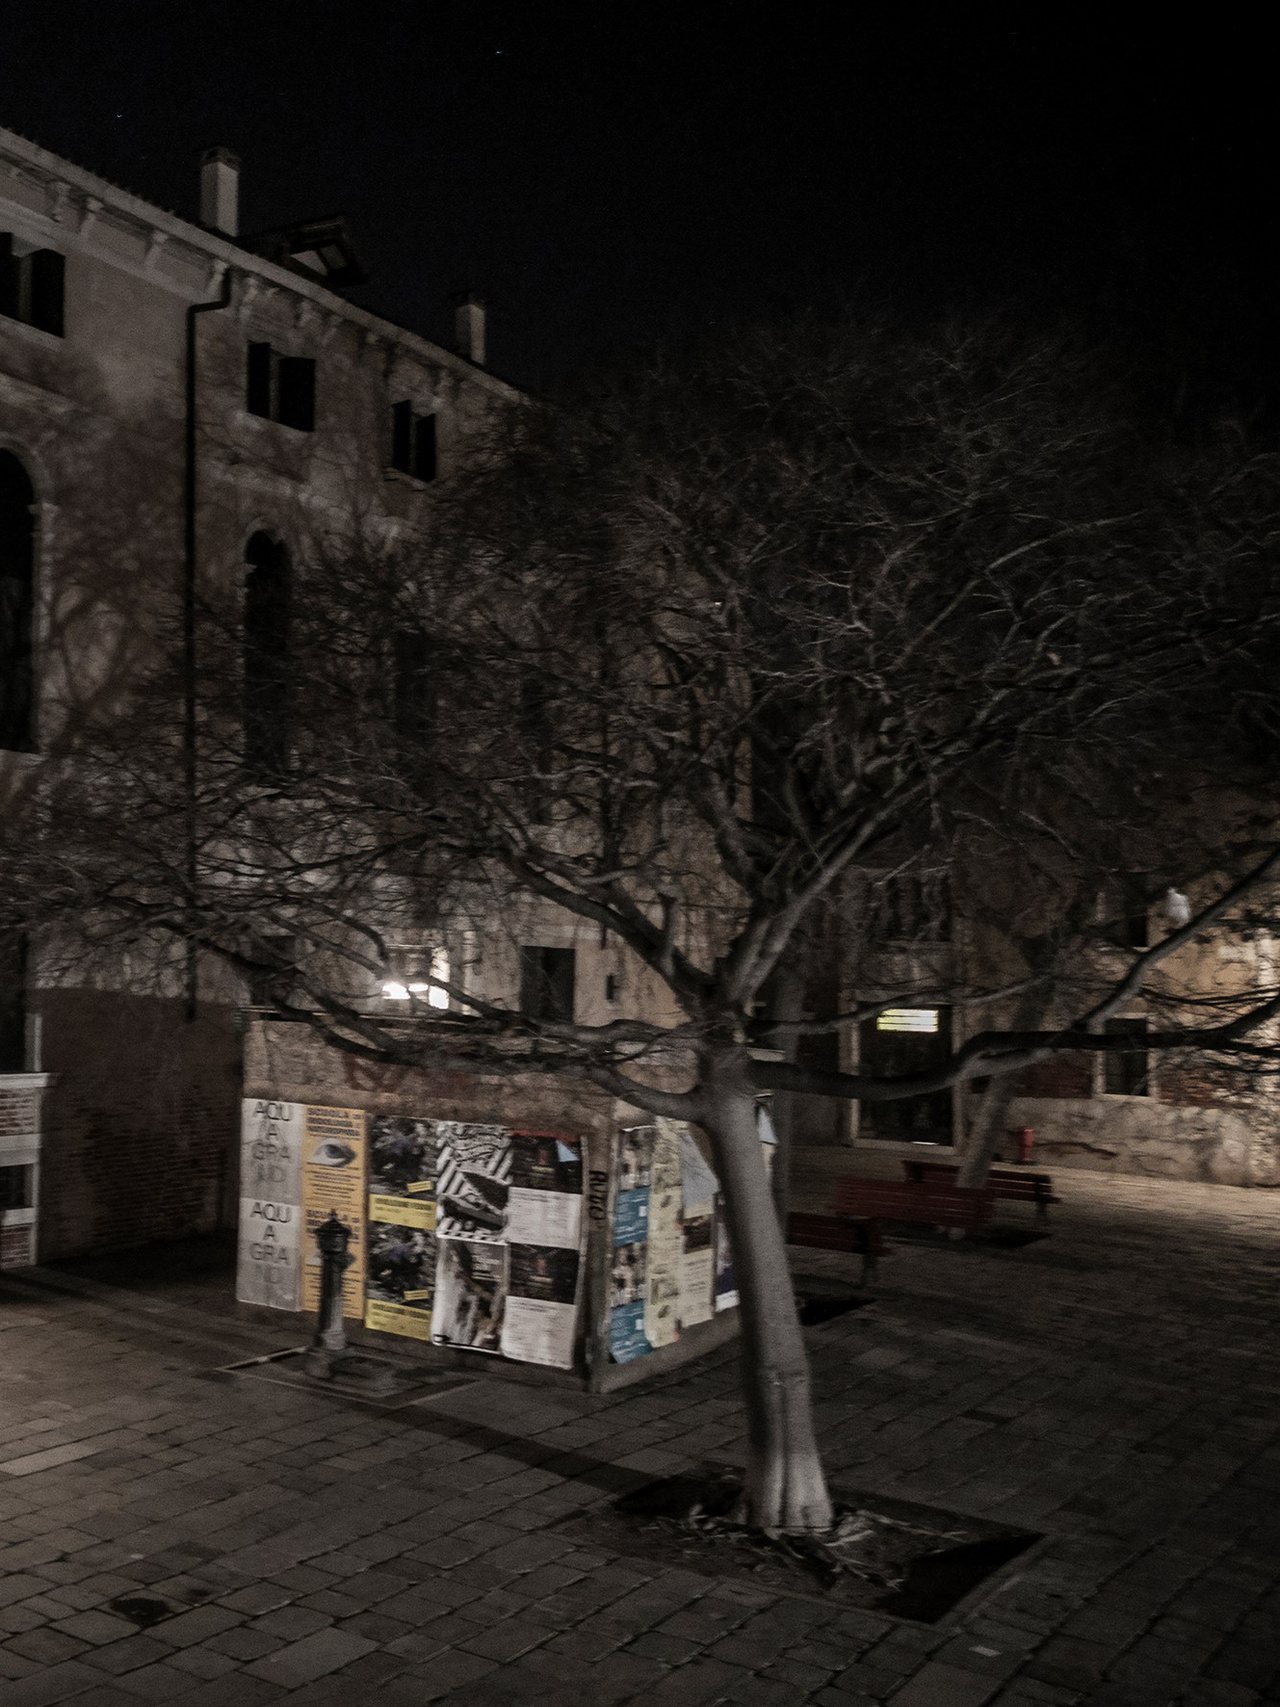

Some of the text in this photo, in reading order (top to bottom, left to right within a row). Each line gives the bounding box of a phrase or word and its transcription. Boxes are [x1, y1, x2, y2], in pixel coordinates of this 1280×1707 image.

[253, 1101, 292, 1121] AQU
[266, 1123, 279, 1140] A
[252, 1142, 290, 1160] GRA
[250, 1201, 291, 1223] AQU
[262, 1224, 277, 1242] A
[249, 1243, 288, 1264] GRA
